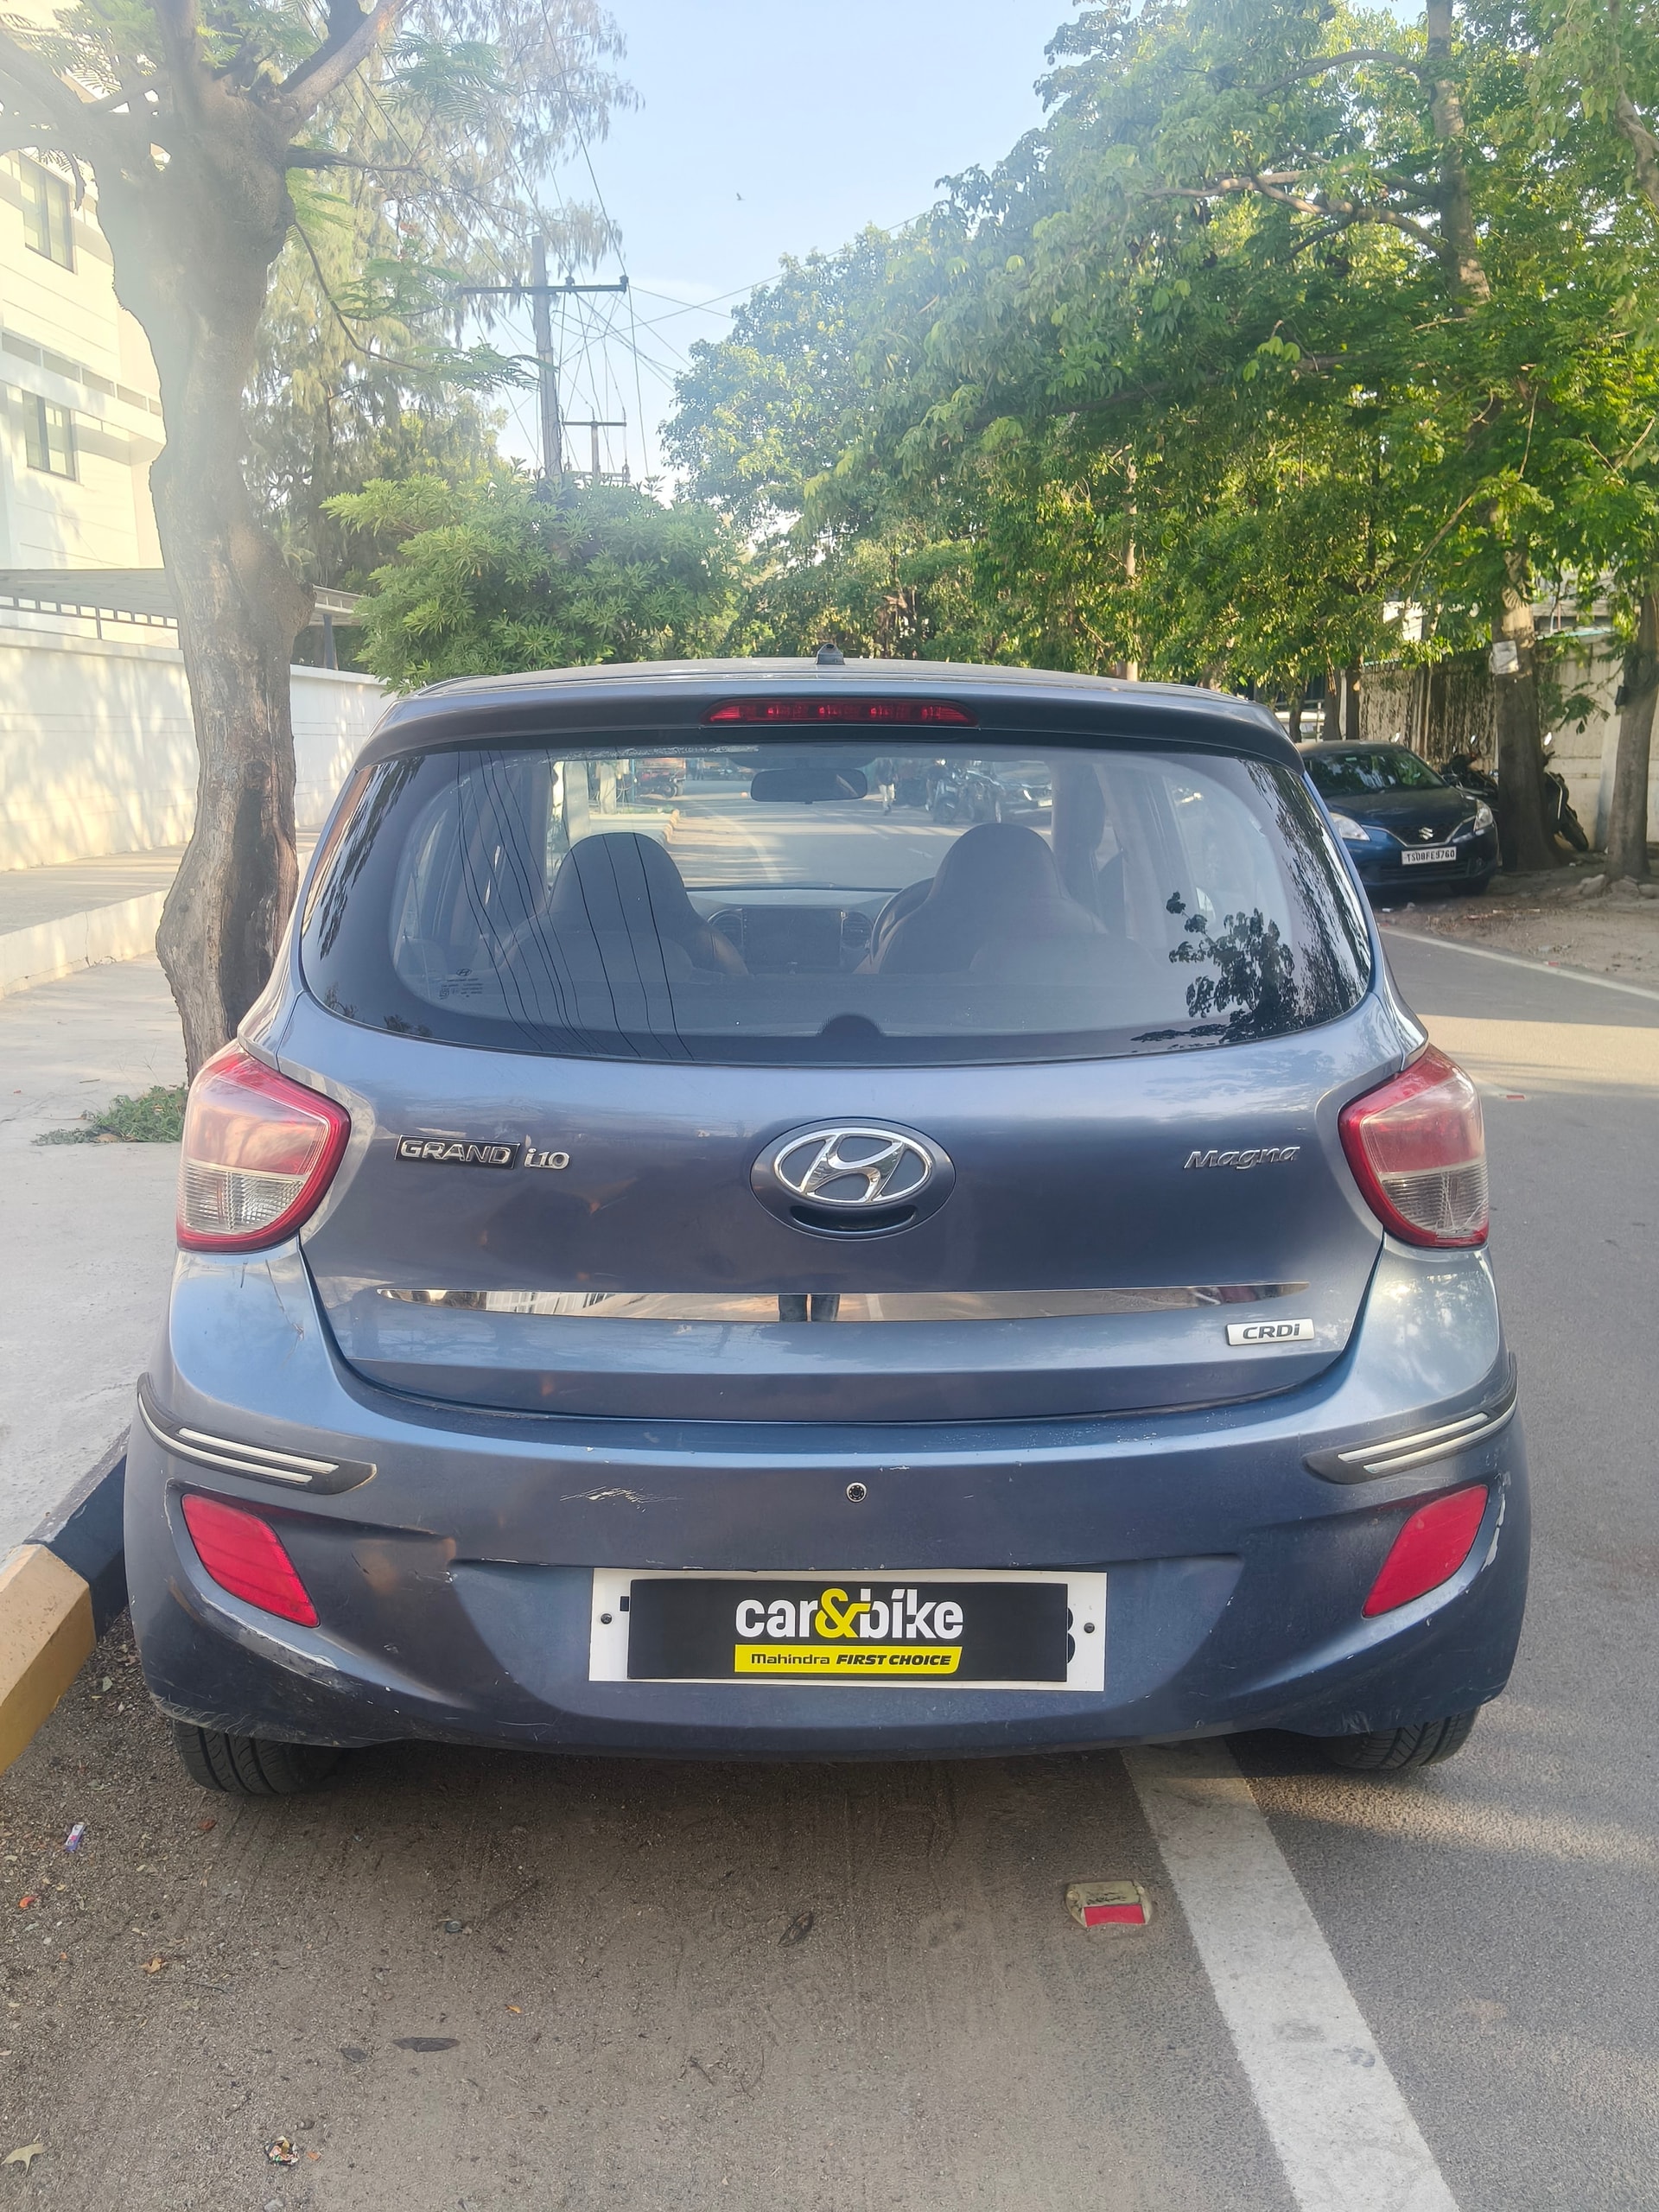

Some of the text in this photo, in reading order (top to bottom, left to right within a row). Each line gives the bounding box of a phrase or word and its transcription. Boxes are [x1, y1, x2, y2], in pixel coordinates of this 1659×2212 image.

[400, 1140, 570, 1170] GRAND i10
[1183, 1146, 1300, 1170] Magna
[1243, 1323, 1300, 1340] CRDi
[735, 1588, 963, 1639] car&bike
[751, 1653, 951, 1666] Mahindra FIRST CHOICE
